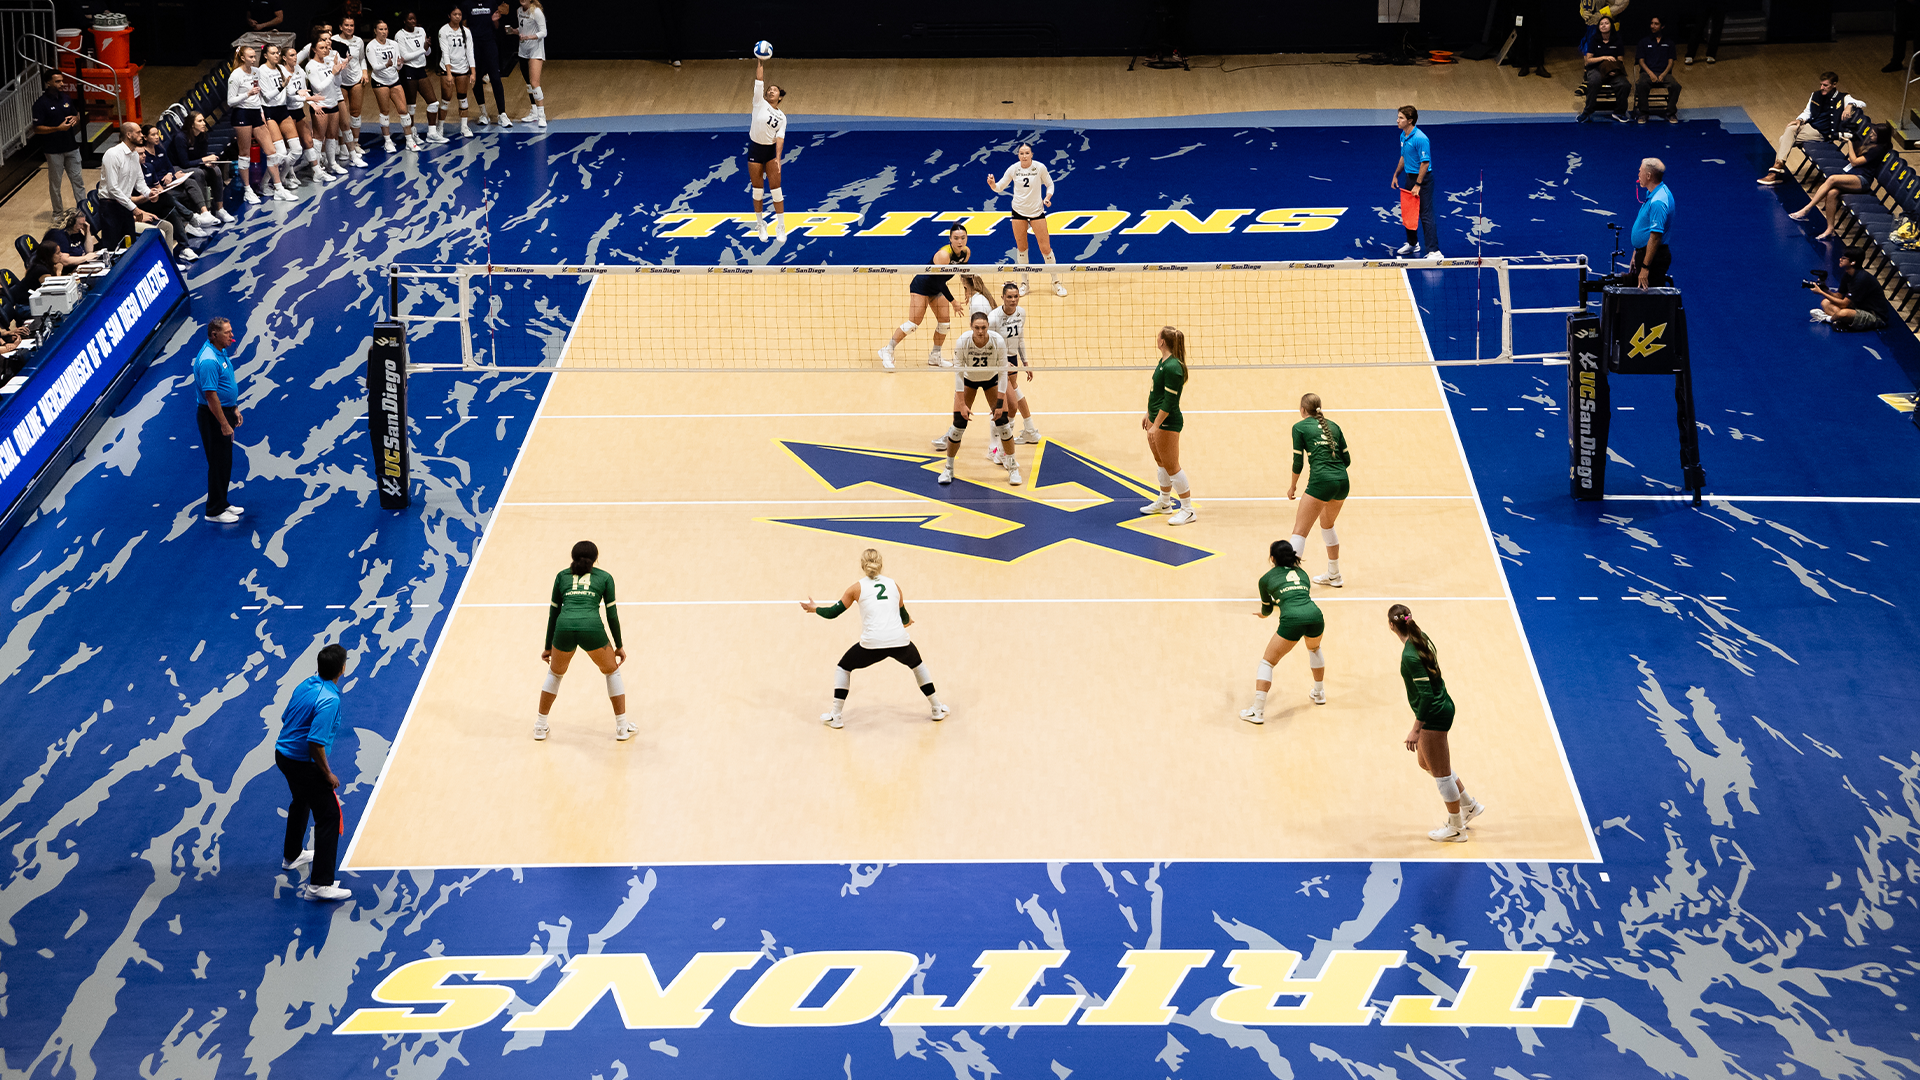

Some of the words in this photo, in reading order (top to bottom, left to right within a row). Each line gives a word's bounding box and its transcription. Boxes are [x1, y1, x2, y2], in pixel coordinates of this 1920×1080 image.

[519, 18, 524, 28] 4
[414, 39, 421, 48] 8
[452, 38, 462, 47] 11
[382, 50, 393, 60] 30
[62, 83, 122, 93] GAORADE
[766, 115, 779, 129] 13
[1022, 177, 1030, 188] 2
[656, 206, 1349, 238] TRITONS
[1007, 325, 1019, 338] 21
[972, 357, 988, 367] 23
[0, 437, 21, 485] ICIAL
[13, 405, 46, 457] ONLINE
[37, 349, 95, 428] MERCHANDISER
[86, 338, 102, 369] OF
[95, 327, 112, 358] UC
[104, 312, 125, 347] SAN
[117, 292, 142, 332] DIEGO
[135, 259, 170, 312] ATHLETICS
[572, 573, 591, 590] 14
[1285, 570, 1300, 585] 4
[874, 583, 889, 600] 2
[1279, 585, 1309, 594] HORNETS
[333, 948, 1584, 1035] TRITONS
